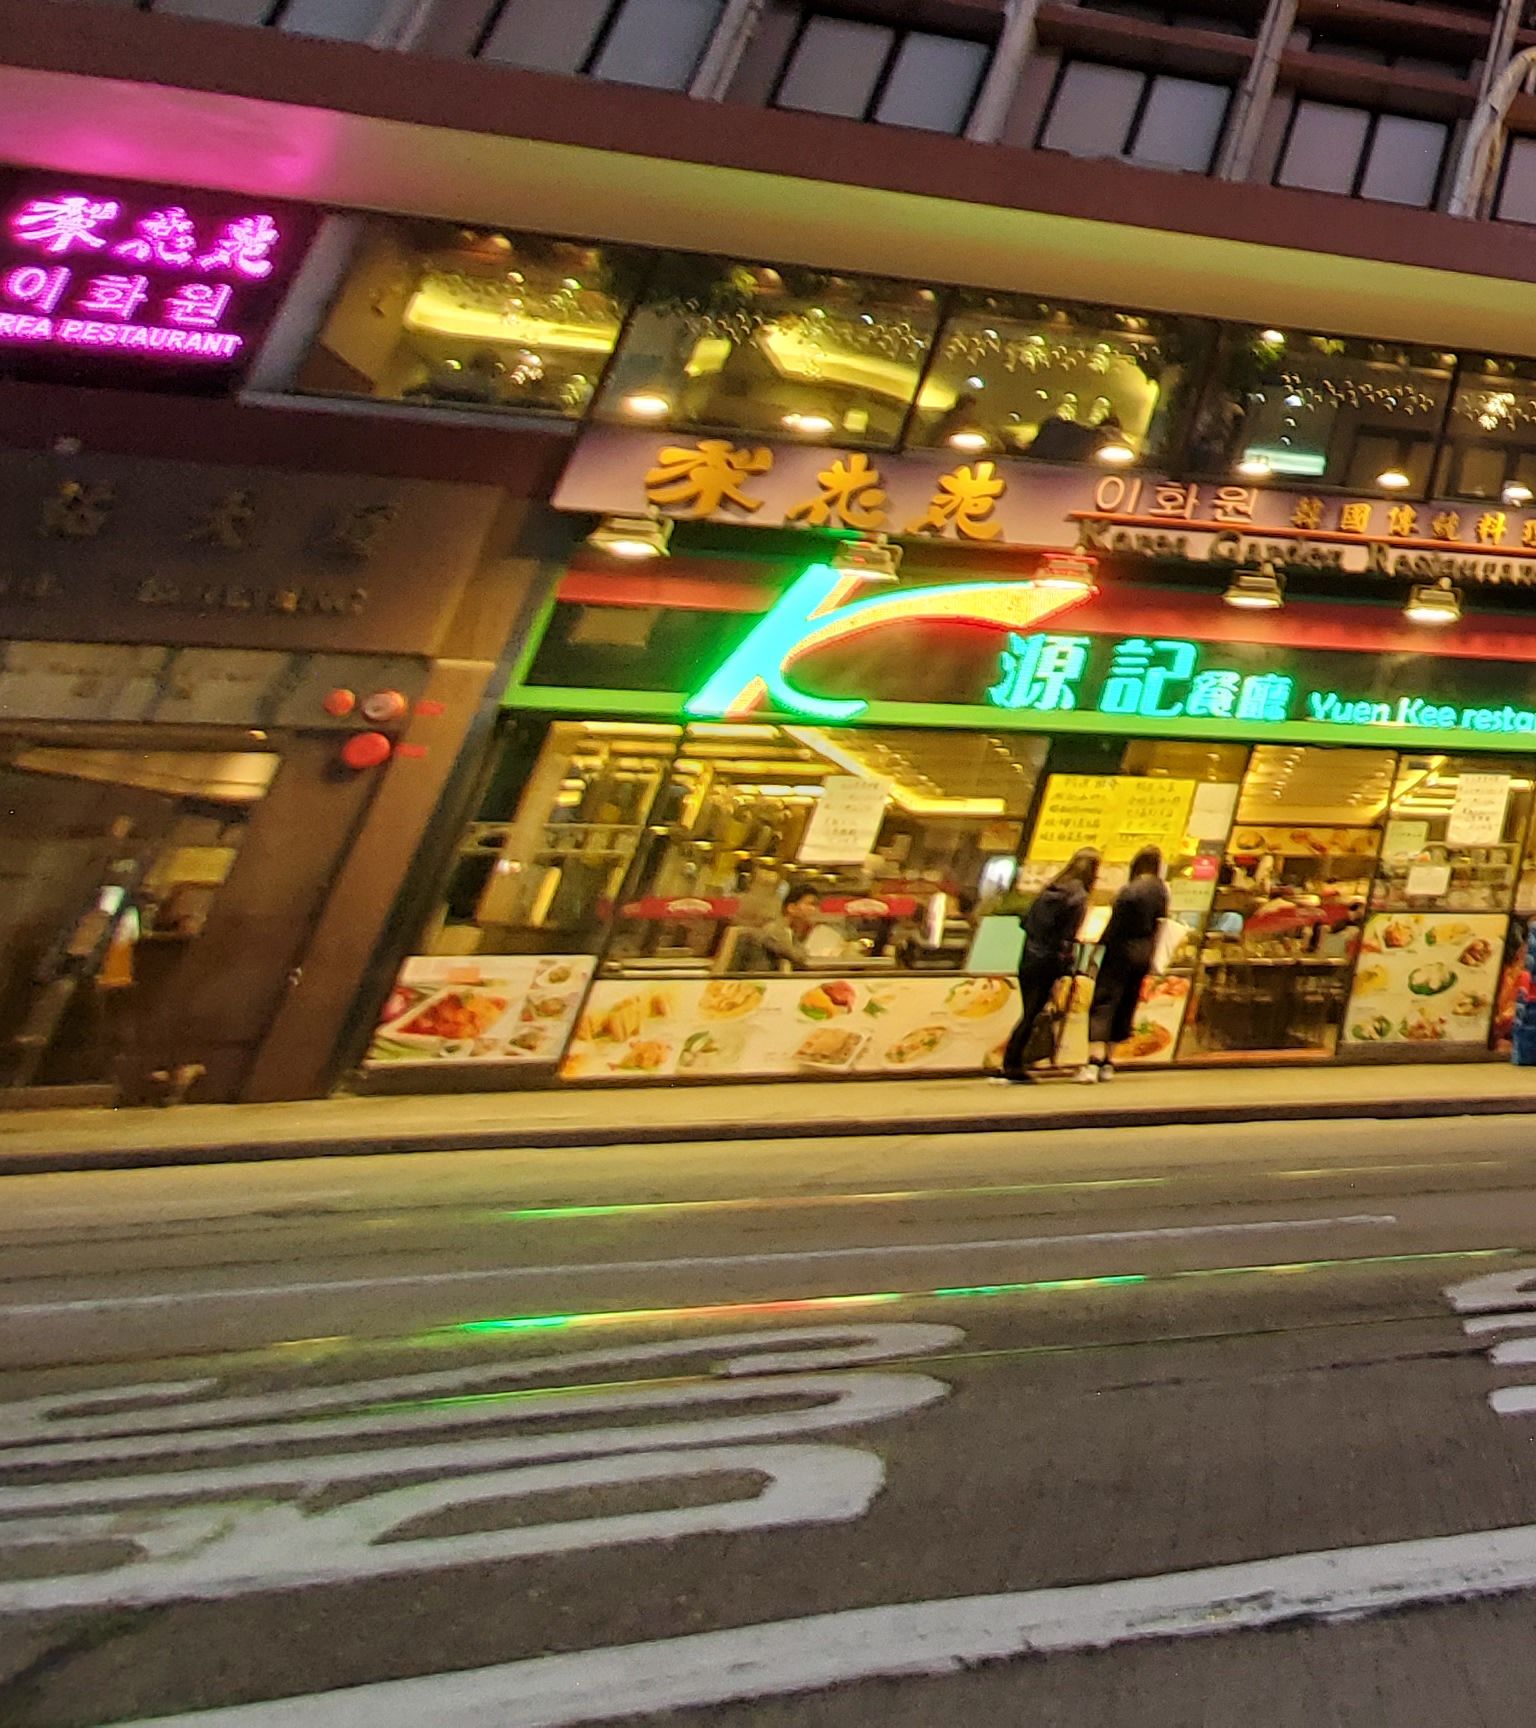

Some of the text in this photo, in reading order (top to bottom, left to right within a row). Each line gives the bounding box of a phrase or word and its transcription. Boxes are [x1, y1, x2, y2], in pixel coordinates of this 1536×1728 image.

[8, 264, 235, 328] 이화원
[57, 318, 243, 357] RESTAURANT
[1094, 475, 1259, 523] 이화원
[1310, 691, 1382, 723] Yuen
[1397, 696, 1458, 728] Kee
